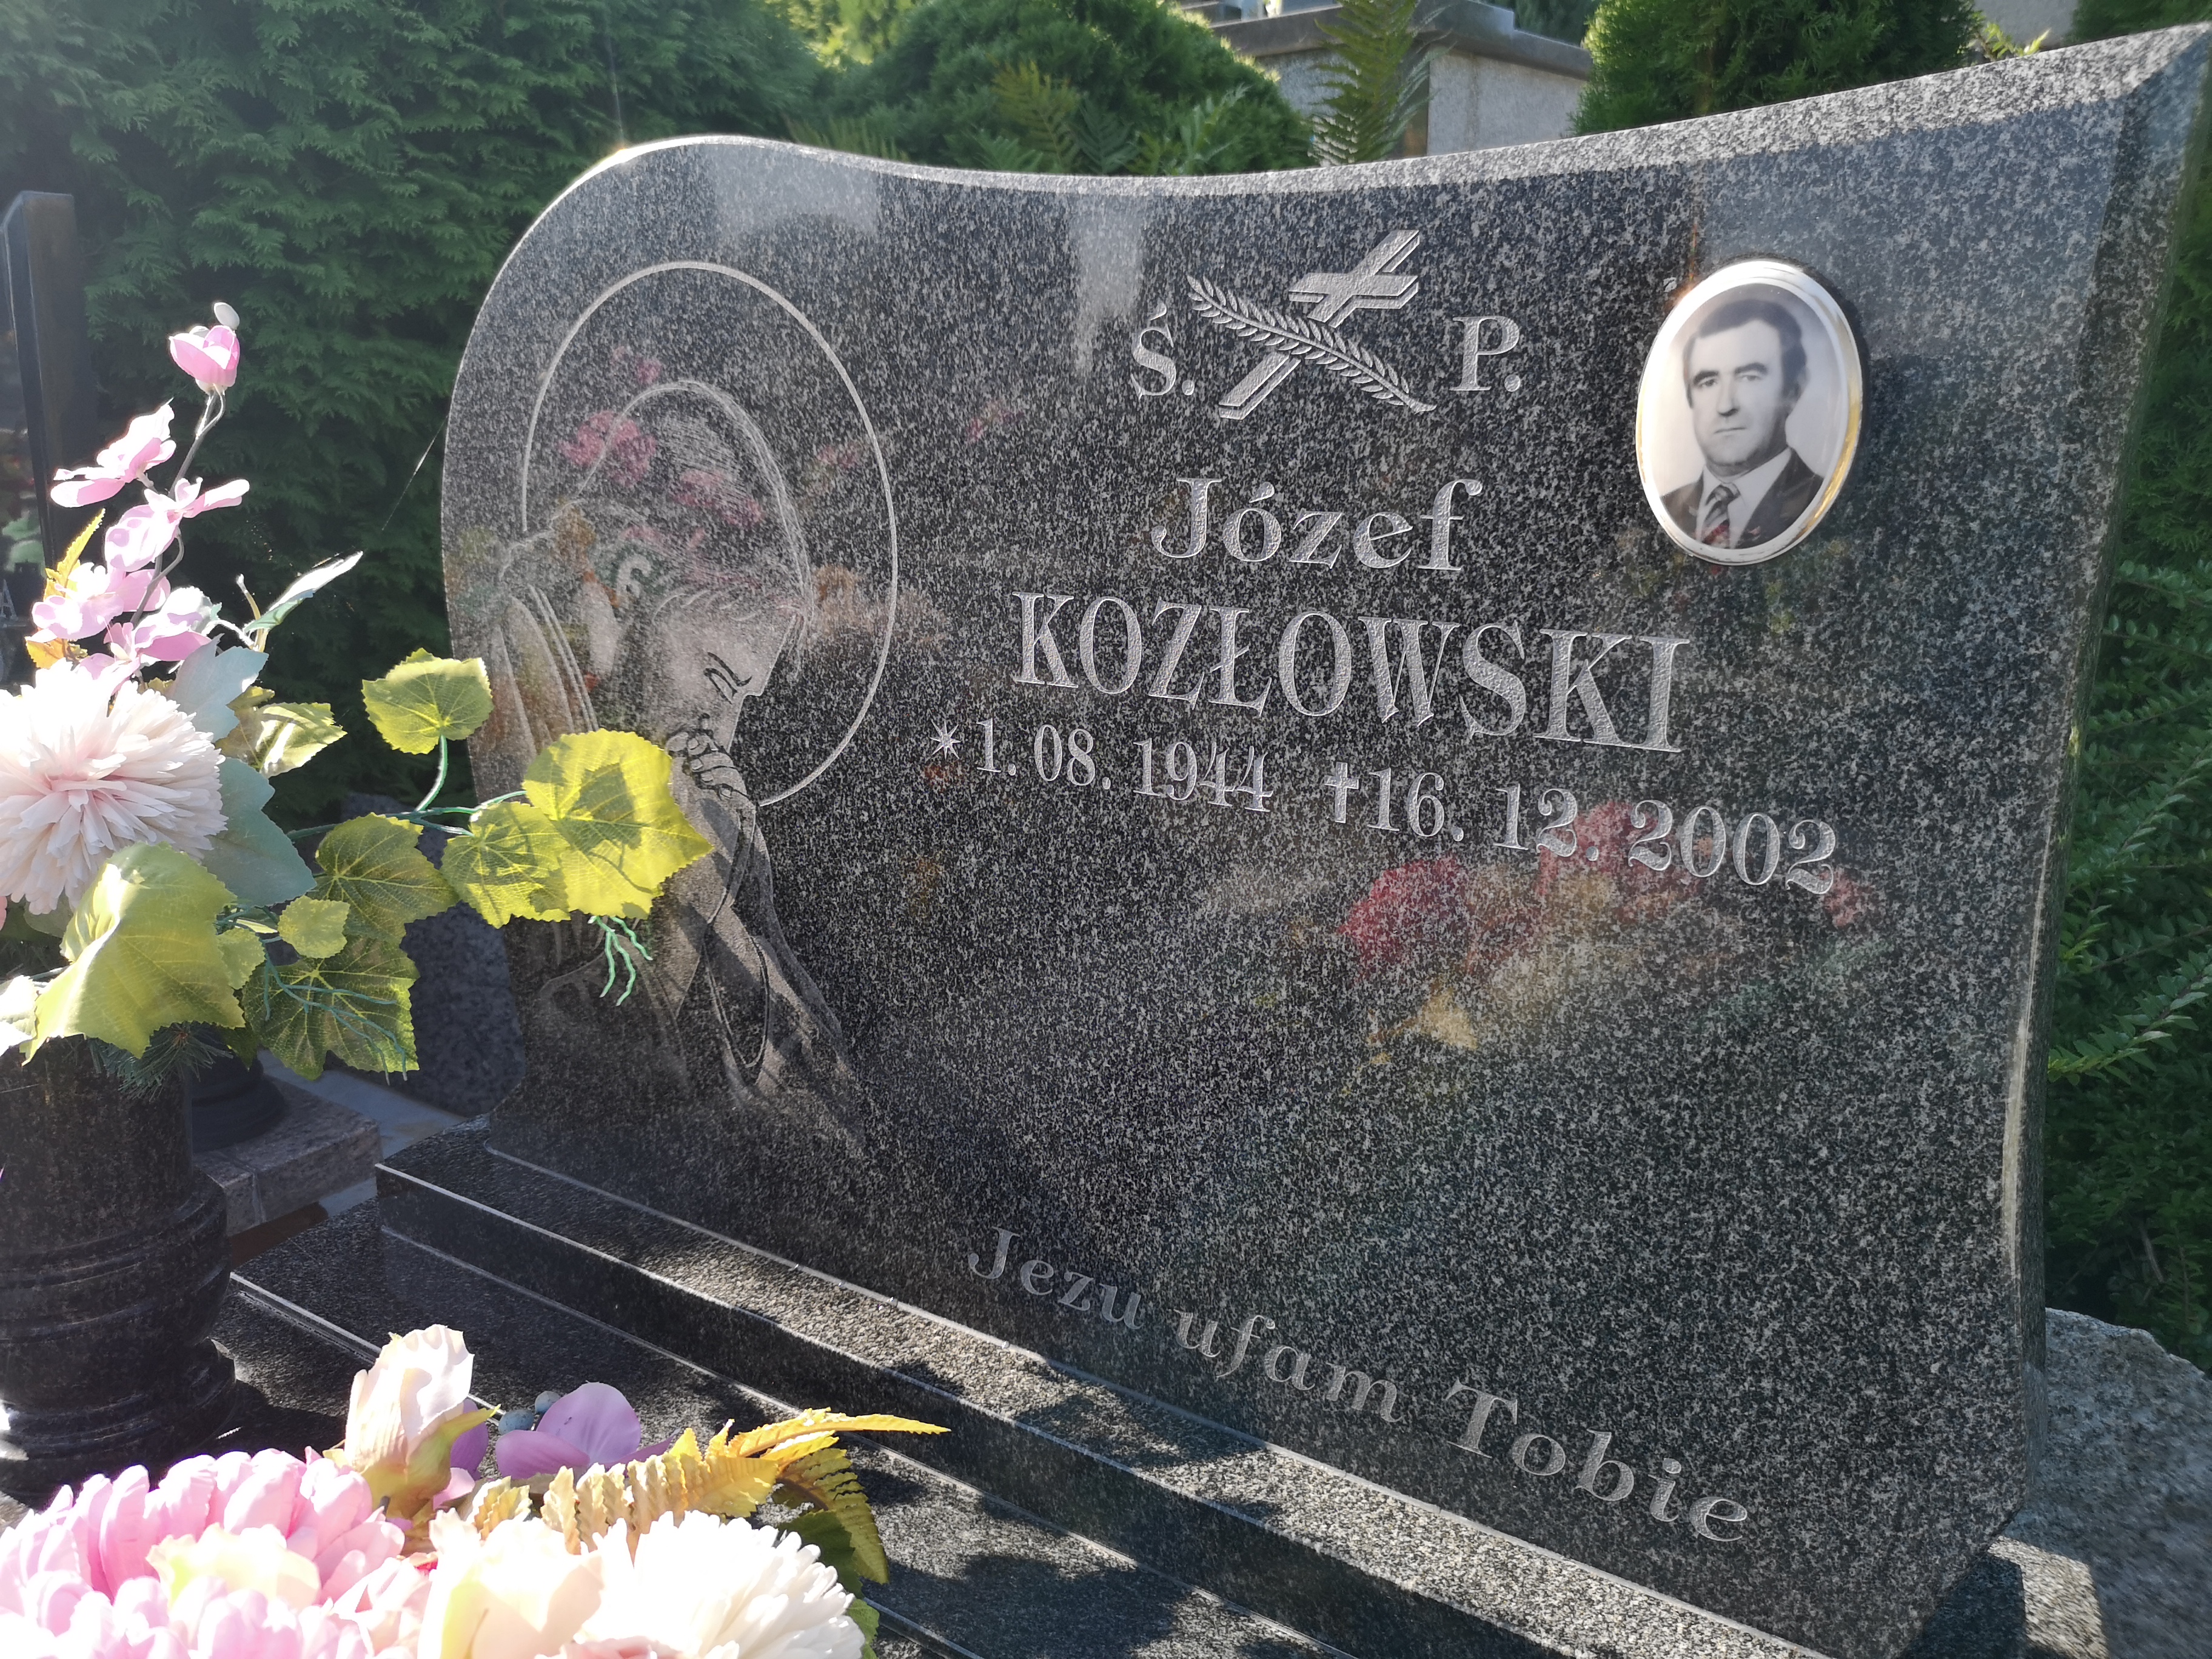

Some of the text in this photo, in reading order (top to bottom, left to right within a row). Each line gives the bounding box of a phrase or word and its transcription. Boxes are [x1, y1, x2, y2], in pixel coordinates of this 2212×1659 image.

[1130, 303, 1521, 400] Ś. P.
[1151, 477, 1483, 571] Józef
[1011, 591, 1691, 754] KOZŁOWSKI
[1034, 724, 1111, 790] 08.
[1133, 737, 1275, 813] 1944
[1493, 783, 1600, 862] 12.
[1627, 799, 1837, 895] 2002
[968, 1225, 1748, 1543] Jezu ufam Tobie
